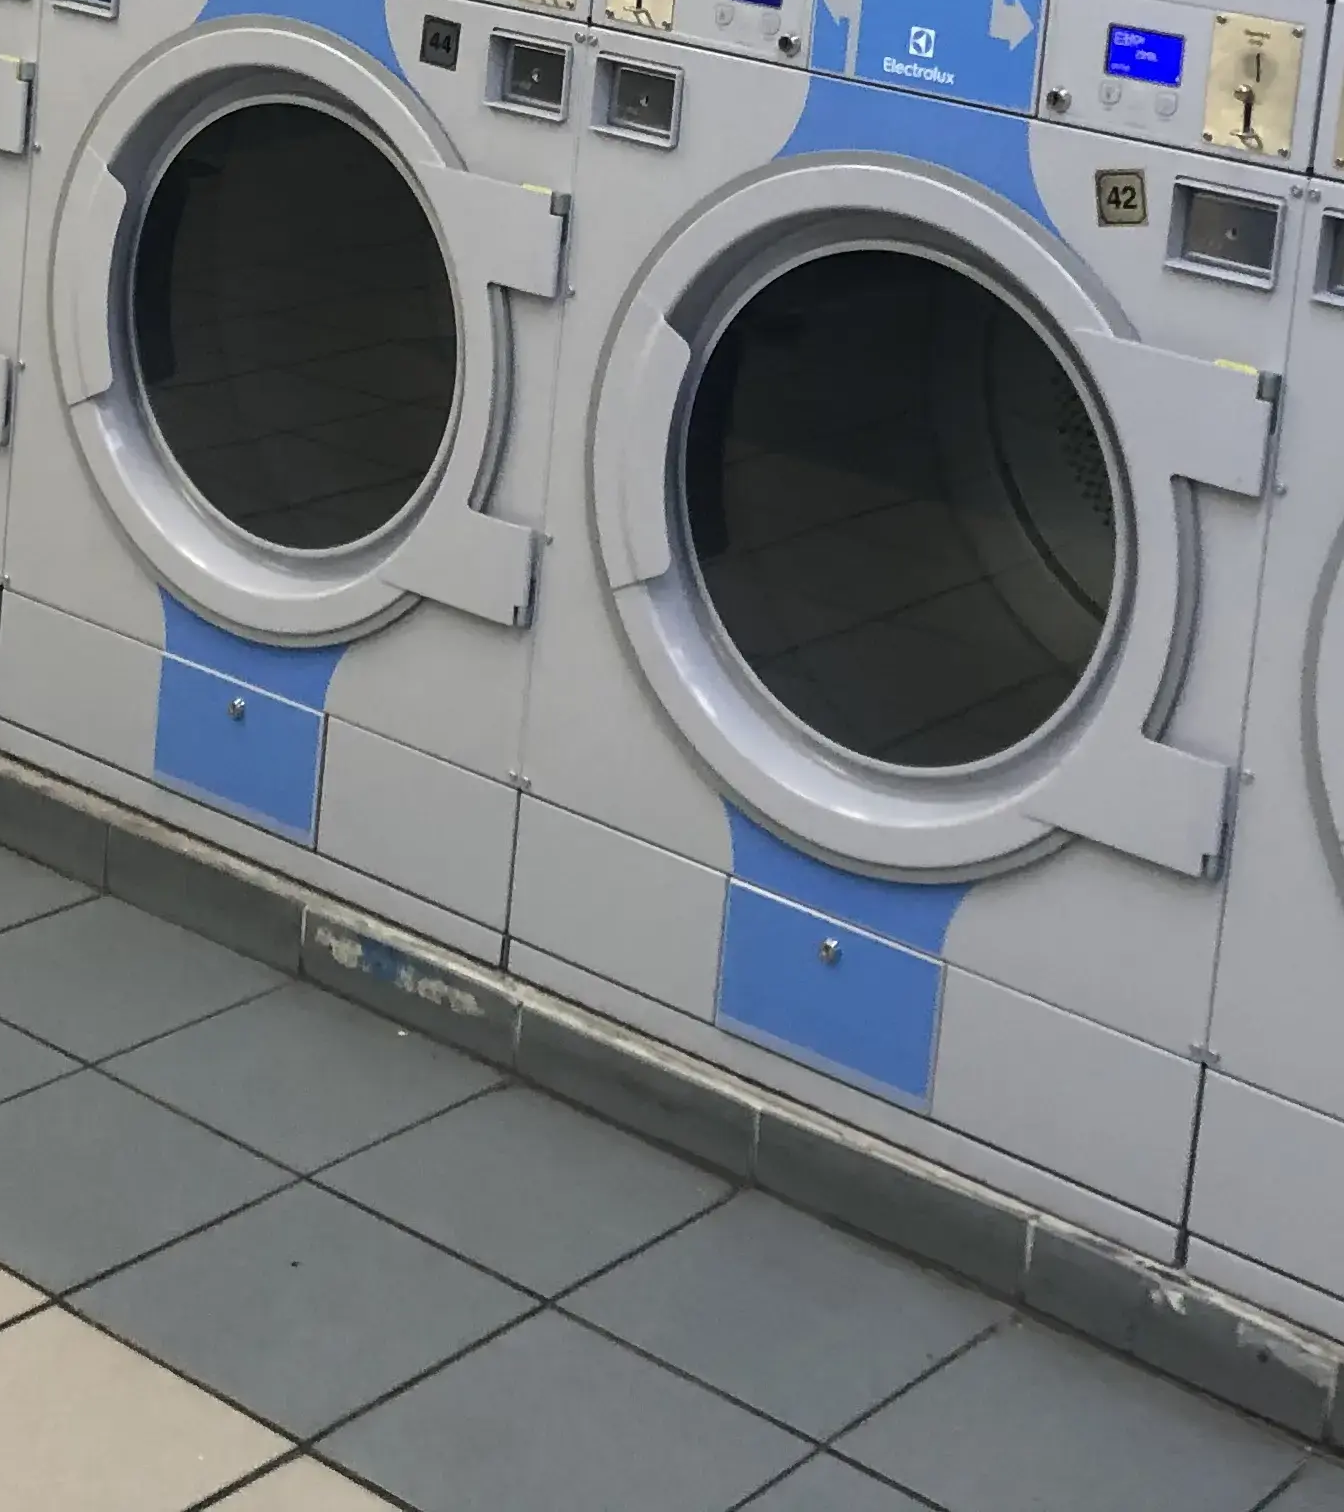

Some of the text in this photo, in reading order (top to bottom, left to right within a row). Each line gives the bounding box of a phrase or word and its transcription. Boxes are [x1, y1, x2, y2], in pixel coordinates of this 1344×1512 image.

[429, 31, 451, 53] 44
[883, 56, 956, 85] Electrolux
[1107, 185, 1137, 209] 42
